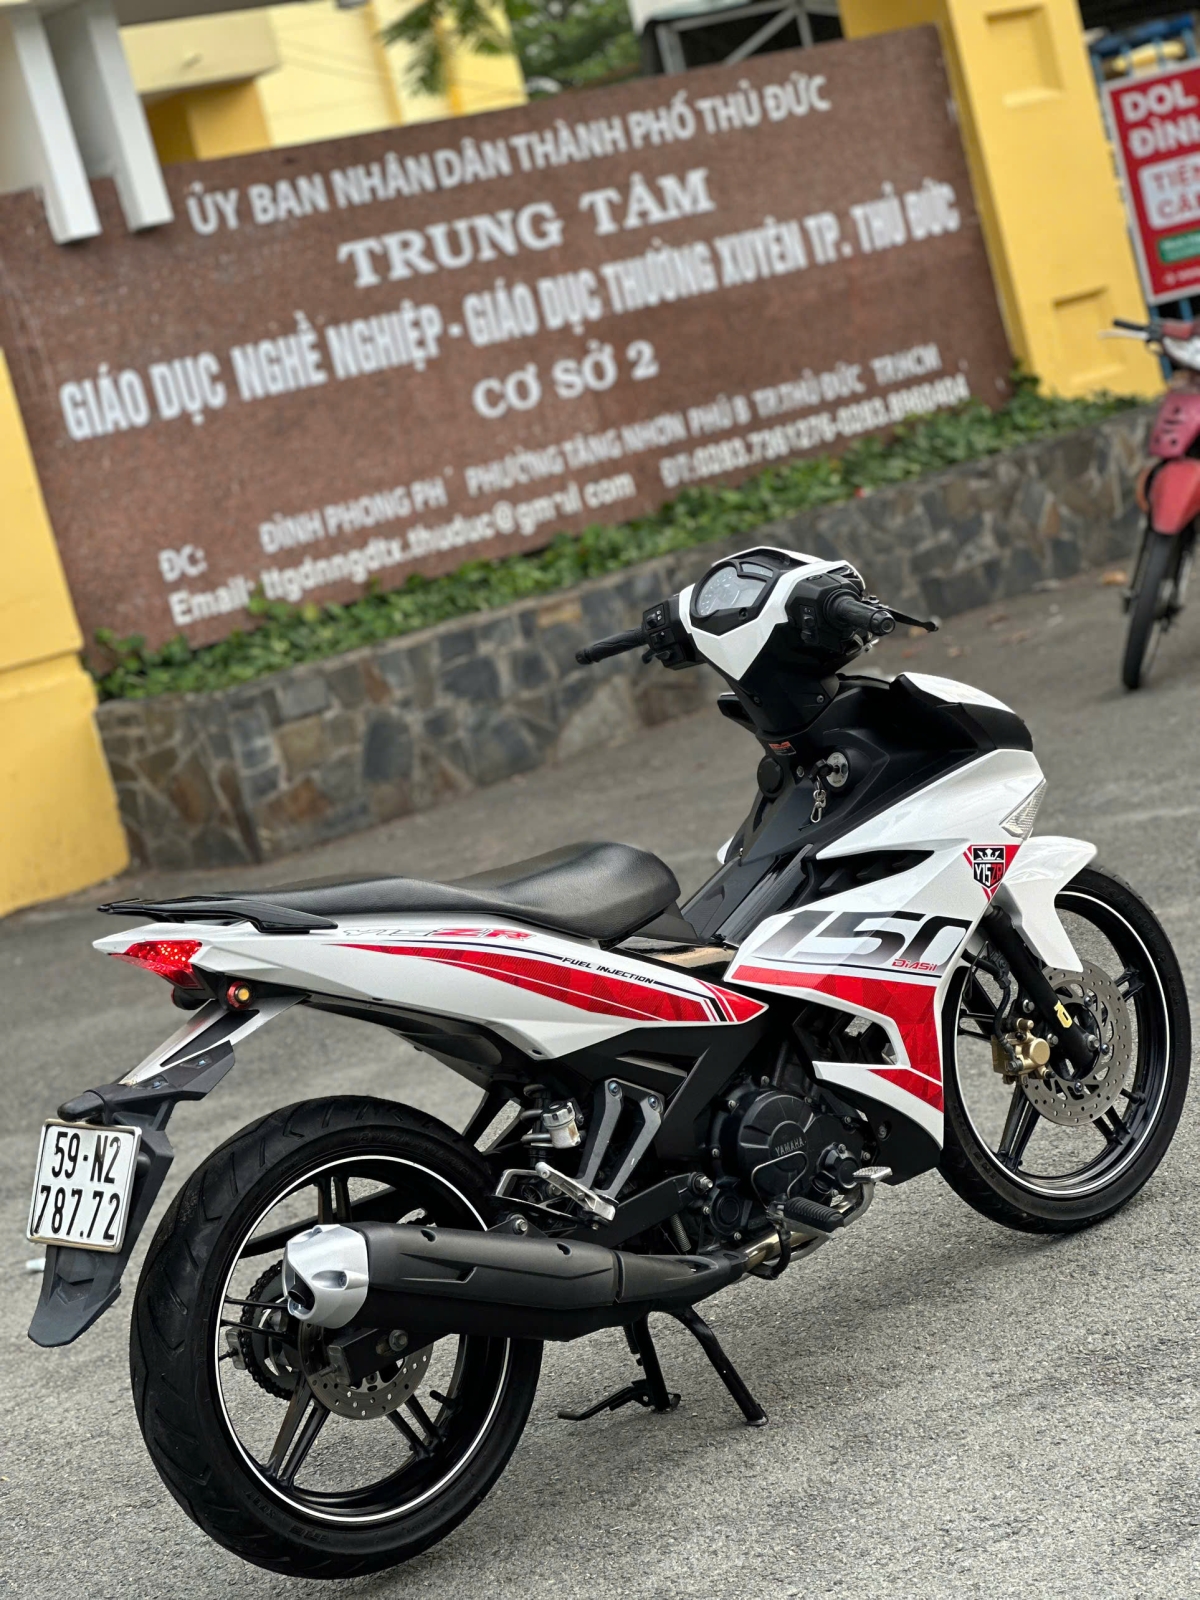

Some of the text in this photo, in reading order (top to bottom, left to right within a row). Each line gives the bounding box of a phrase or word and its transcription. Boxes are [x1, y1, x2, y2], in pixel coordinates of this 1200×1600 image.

[1120, 79, 1198, 123] DOL
[187, 70, 832, 236] ỦY BAN NHÂN DÂN THÀNH PHỐ THỦ ĐỨC
[337, 166, 717, 289] TRUNG TÂM
[59, 361, 150, 441] GIÁO
[148, 351, 228, 426] DỤC
[230, 309, 329, 402] NGHỀ
[325, 299, 443, 381] NGHIỆP
[463, 277, 540, 347] GIÁO
[536, 269, 603, 336] DỤC
[600, 236, 719, 314] THƯỜNG
[713, 214, 809, 287] XUYÊN
[804, 210, 853, 266] TP.
[850, 179, 907, 254] THỦ
[471, 338, 660, 420] CƠ SỞ 2
[258, 511, 325, 554] ĐÌNH
[323, 485, 412, 537] PHONG
[562, 957, 655, 985] FUEL INJECTION
[51, 1131, 121, 1184] 59-N2
[775, 1136, 805, 1157] YAMAHA
[34, 1185, 120, 1241] 787.72
